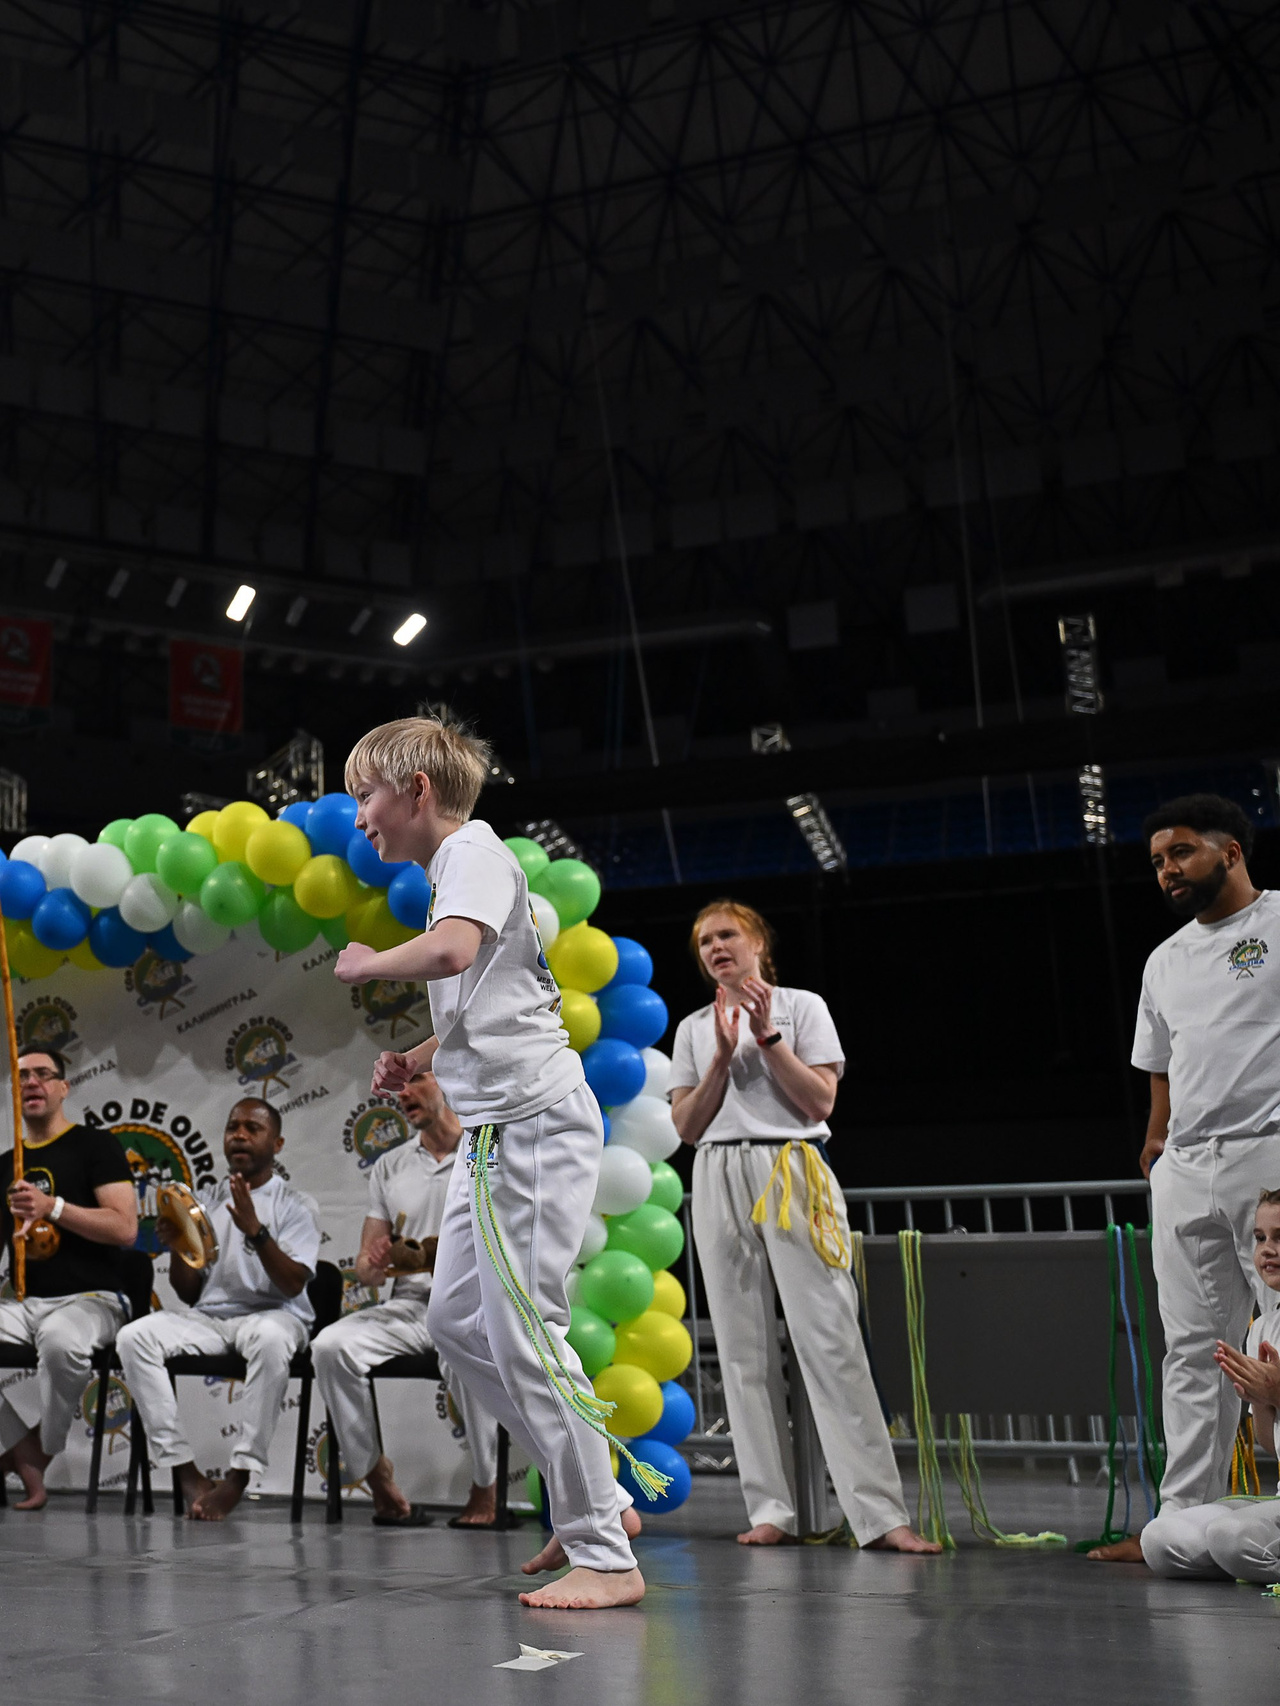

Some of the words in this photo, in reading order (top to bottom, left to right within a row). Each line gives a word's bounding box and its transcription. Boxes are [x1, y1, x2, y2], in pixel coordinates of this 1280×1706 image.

[249, 1016, 264, 1027] DE
[129, 1098, 168, 1124] DE
[343, 1103, 366, 1152] CORDÃO
[339, 1257, 354, 1268] DE
[436, 1382, 447, 1419] CORD
